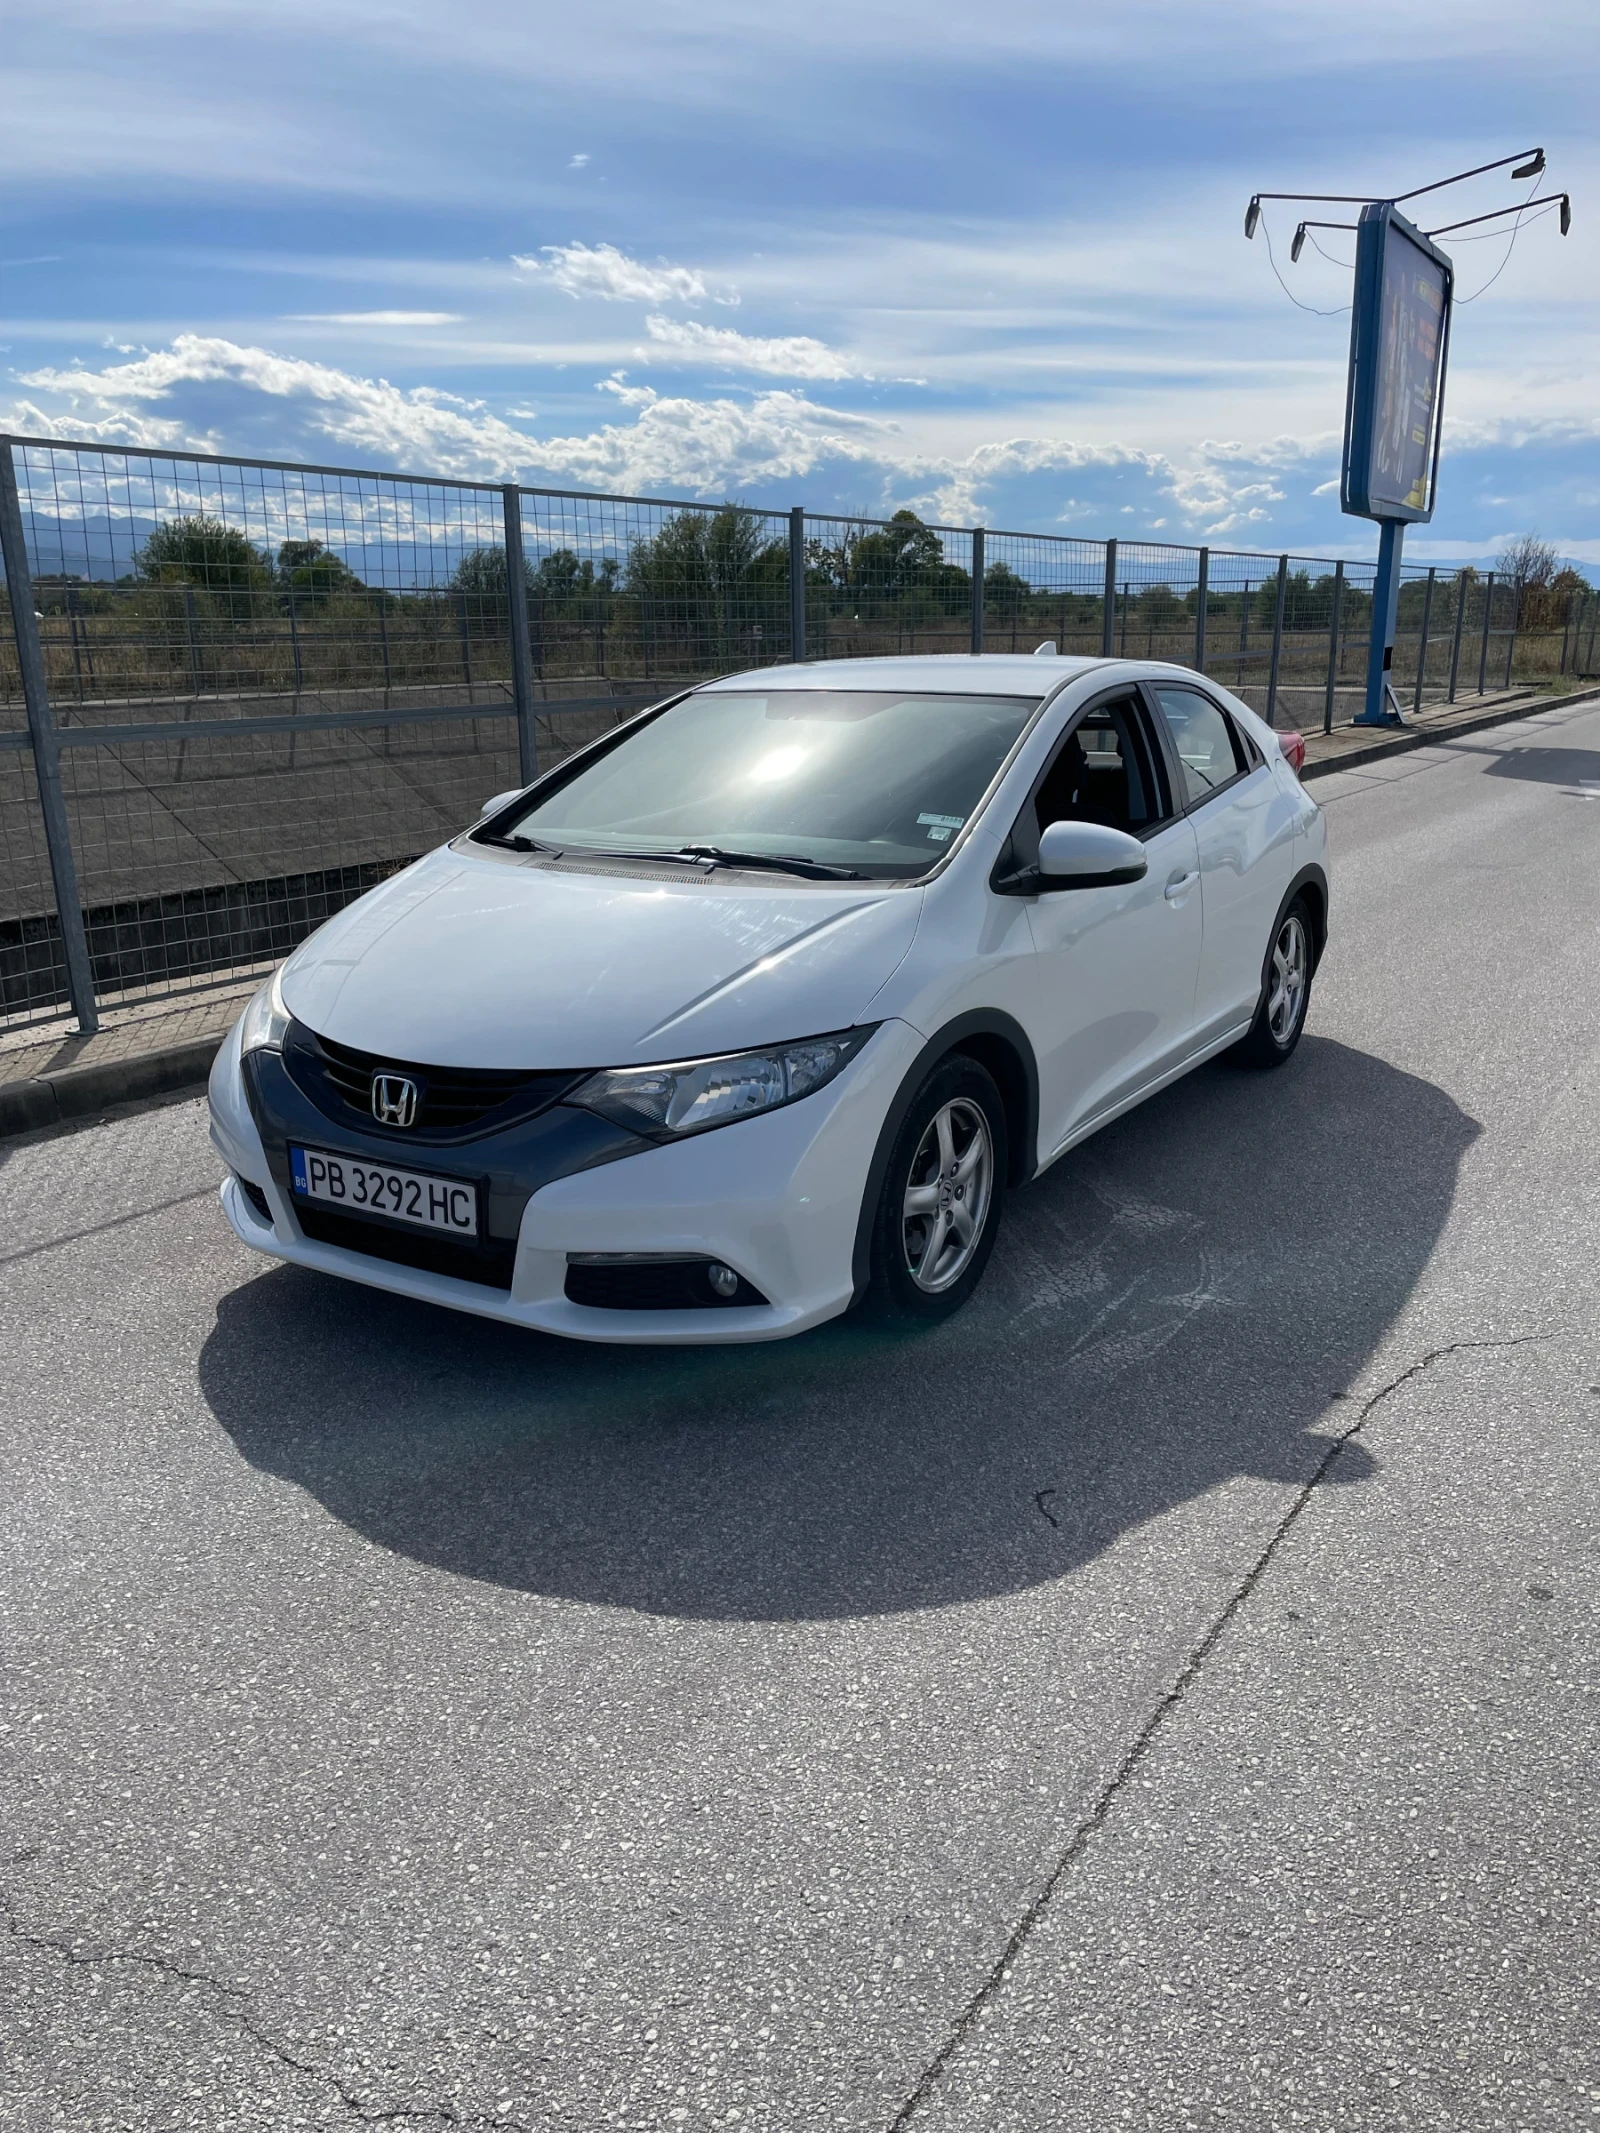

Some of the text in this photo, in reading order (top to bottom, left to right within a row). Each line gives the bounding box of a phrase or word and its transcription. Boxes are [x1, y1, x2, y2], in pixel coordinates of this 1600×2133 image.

[295, 1176, 307, 1188] BG
[309, 1157, 470, 1228] PB 3292 HC
